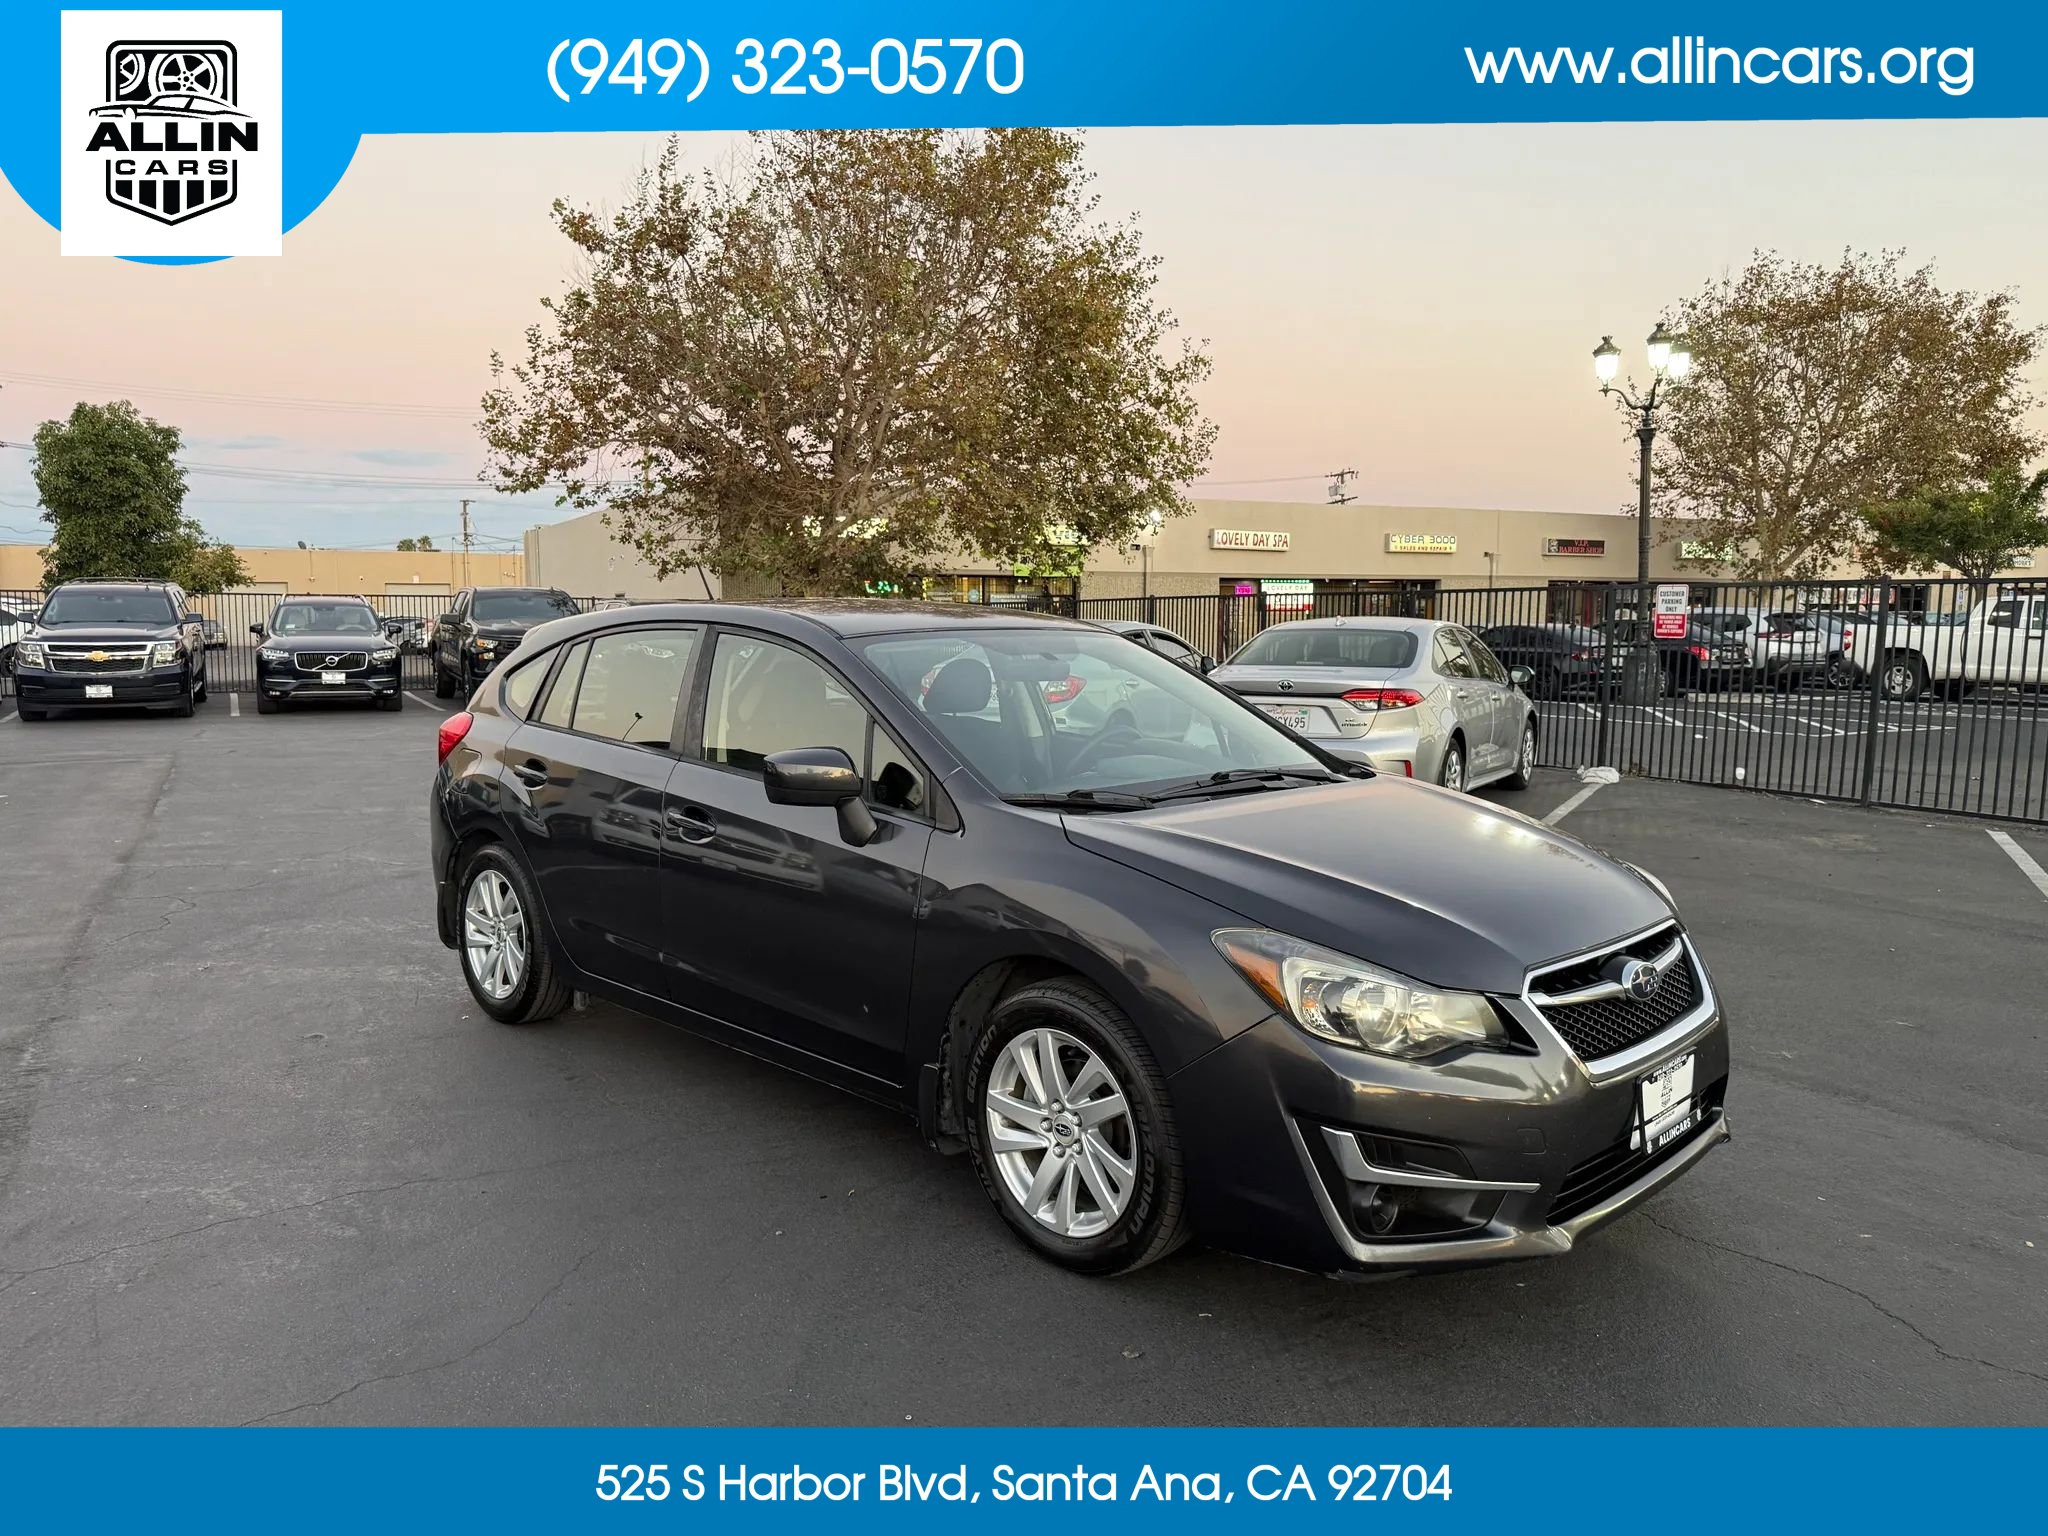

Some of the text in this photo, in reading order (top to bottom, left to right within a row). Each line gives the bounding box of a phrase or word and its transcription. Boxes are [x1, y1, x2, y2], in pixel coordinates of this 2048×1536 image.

[1216, 532, 1289, 548] LOVELY DAY SPA
[1390, 534, 1456, 544] CYBER 3000
[1659, 1117, 1691, 1147] ALLINCARS
